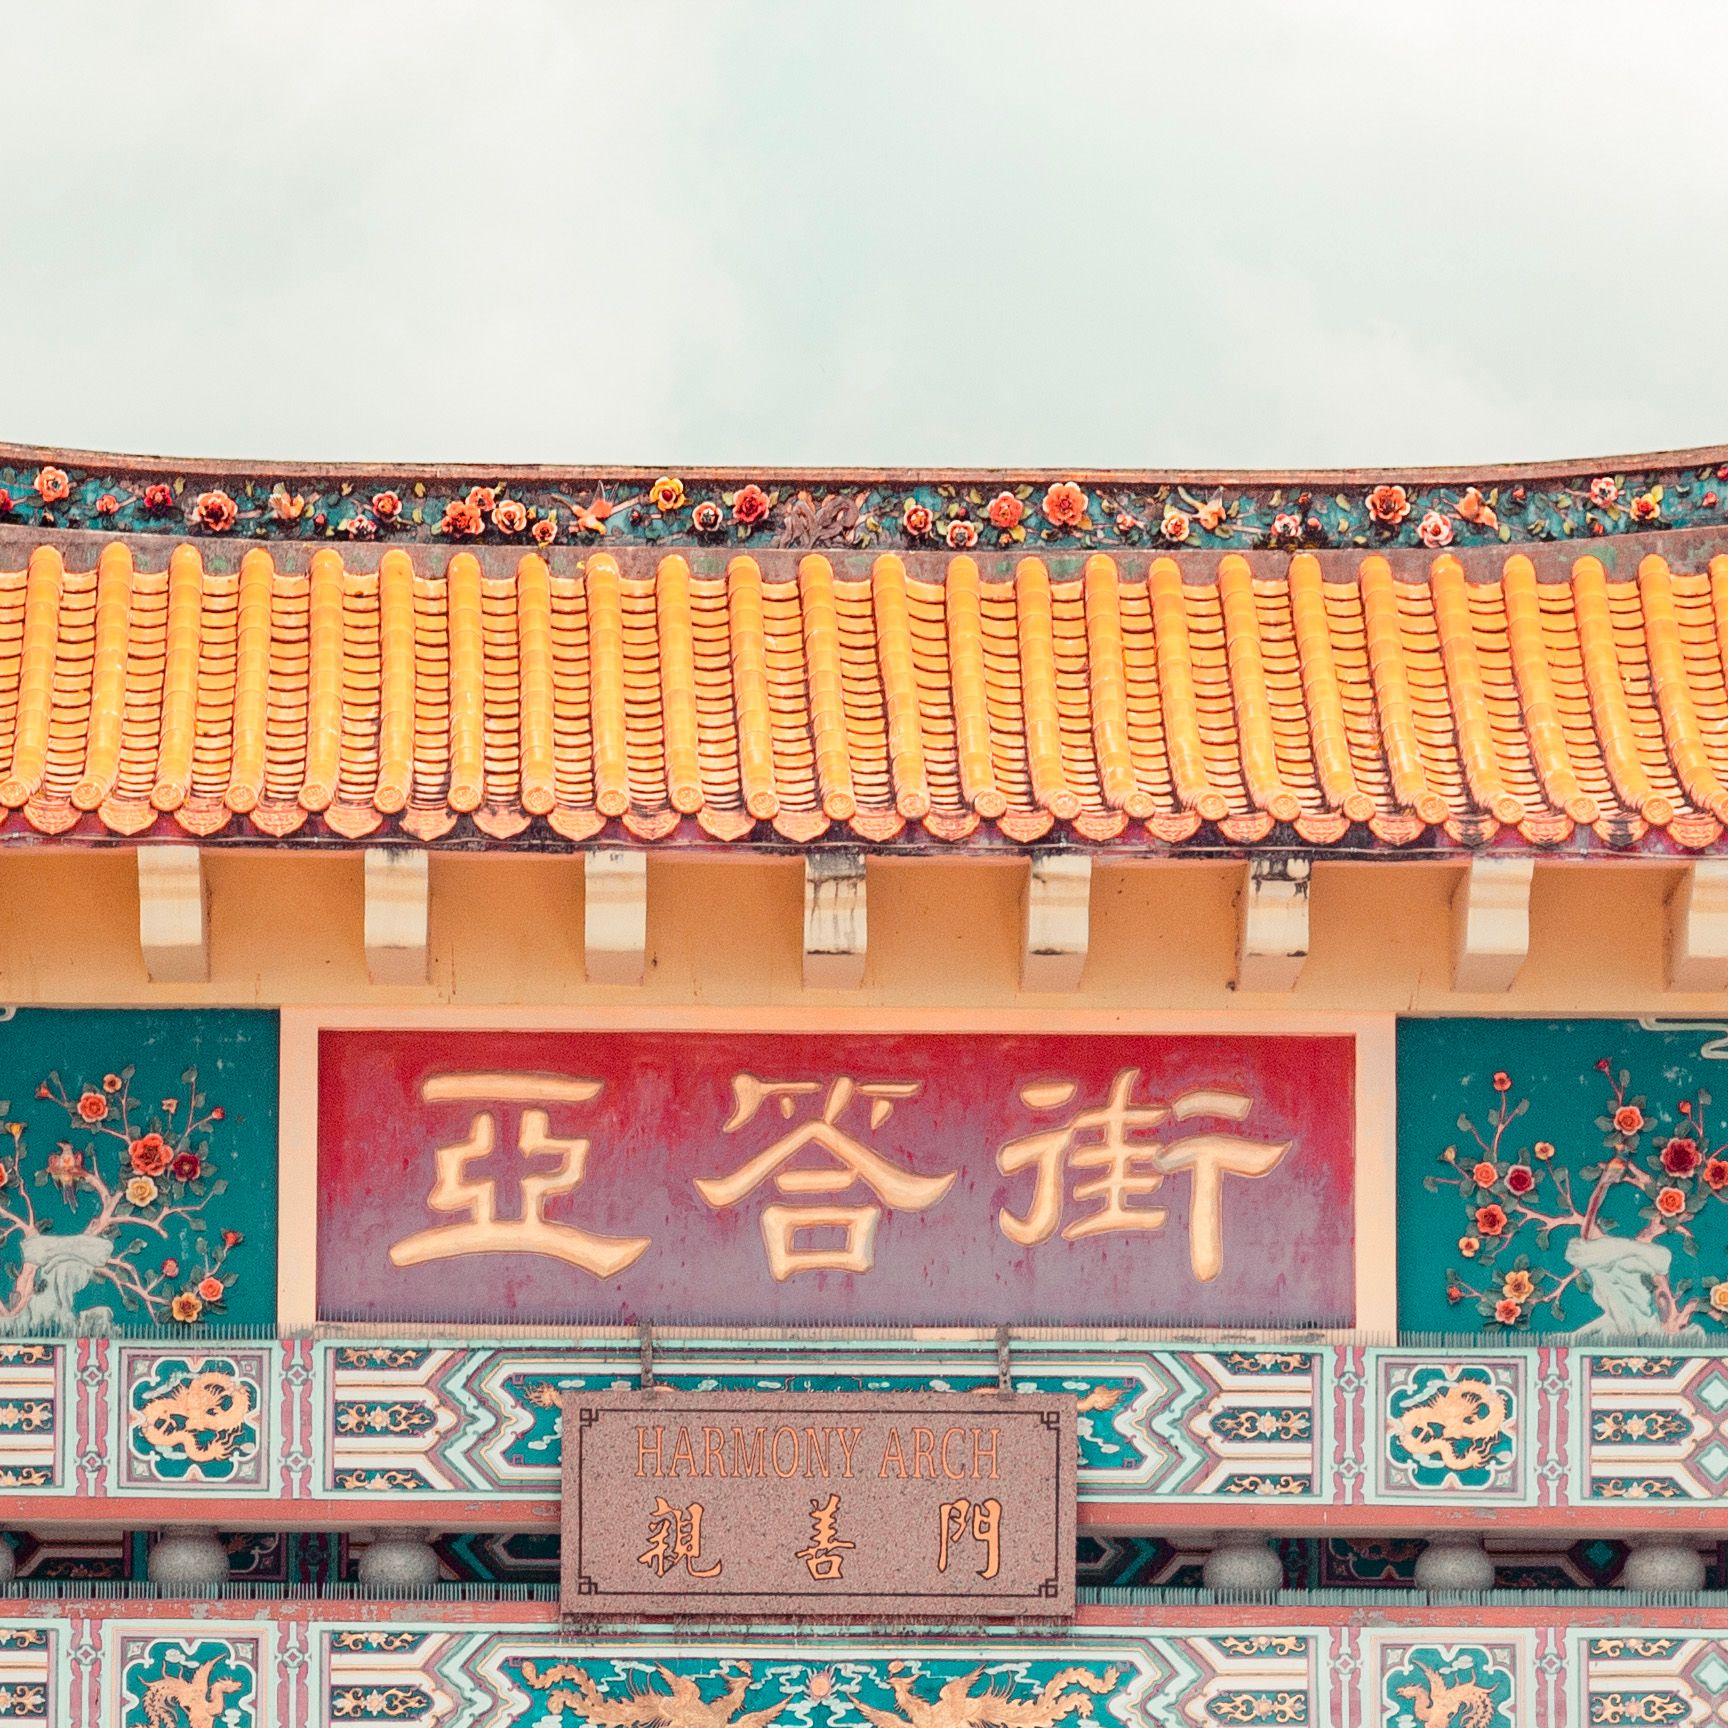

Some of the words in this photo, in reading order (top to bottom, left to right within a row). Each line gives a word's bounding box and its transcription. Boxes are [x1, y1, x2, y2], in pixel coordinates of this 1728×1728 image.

[389, 1067, 1293, 1281] 亞答街
[635, 1425, 862, 1479] HARMONY
[879, 1427, 1000, 1480] ARCH
[637, 1493, 1003, 1580] 親善門
